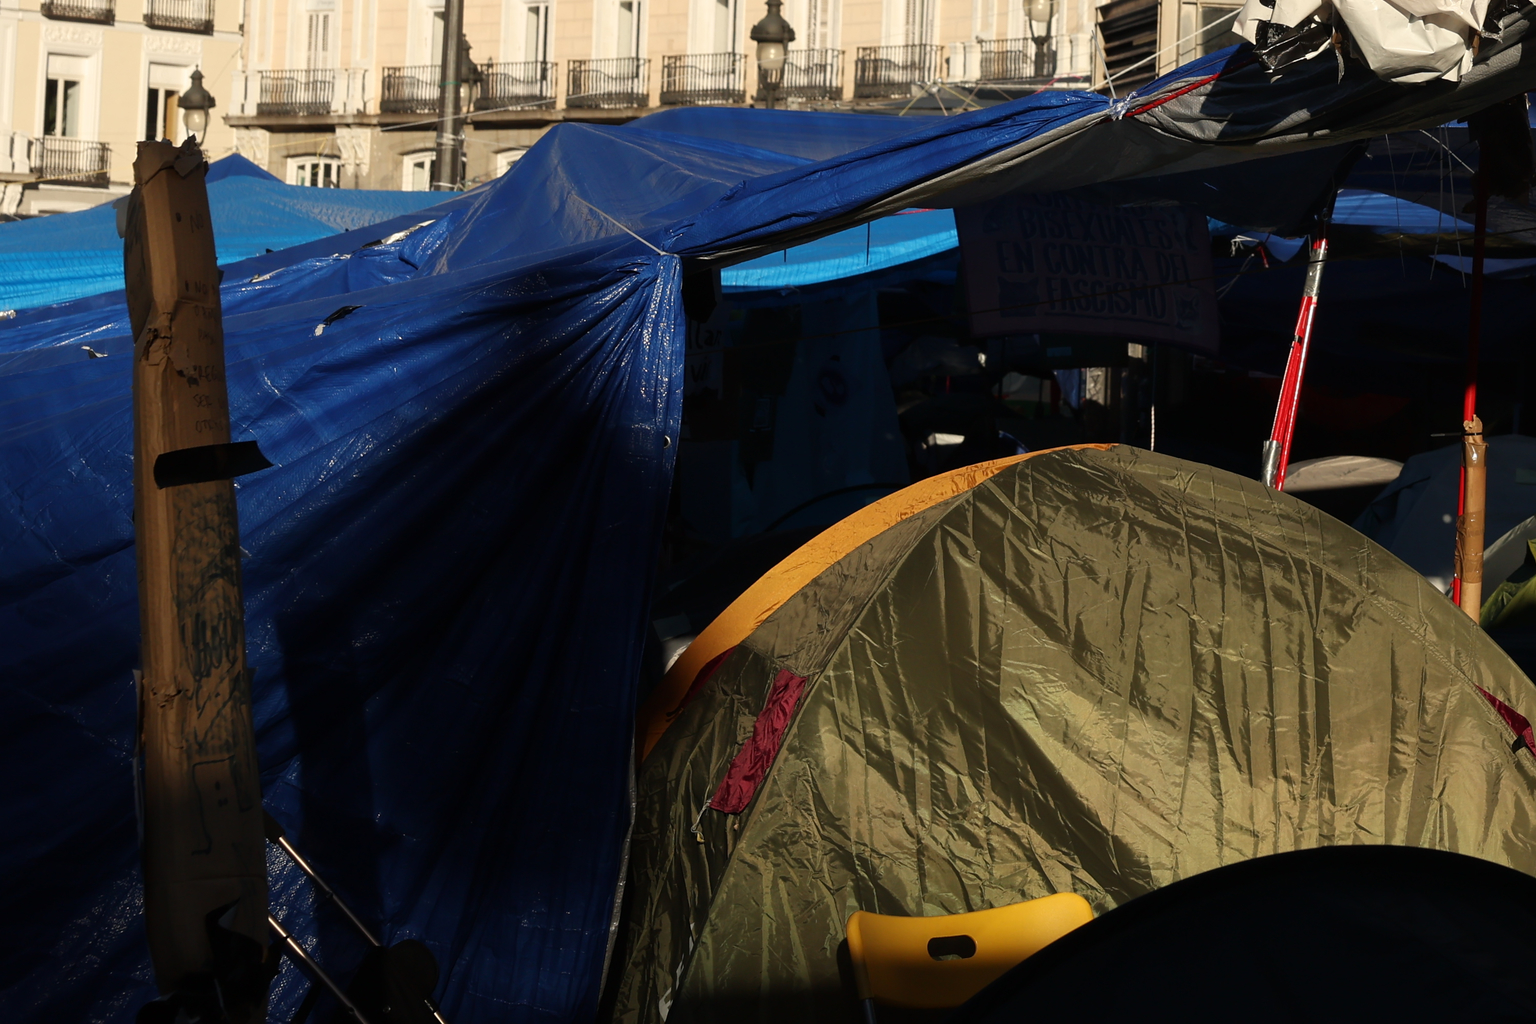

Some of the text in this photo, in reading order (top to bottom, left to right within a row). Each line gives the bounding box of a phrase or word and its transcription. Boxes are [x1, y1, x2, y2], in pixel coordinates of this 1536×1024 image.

[1016, 205, 1173, 250] BISEXUALES
[996, 240, 1199, 289] EN CONTRA DEL
